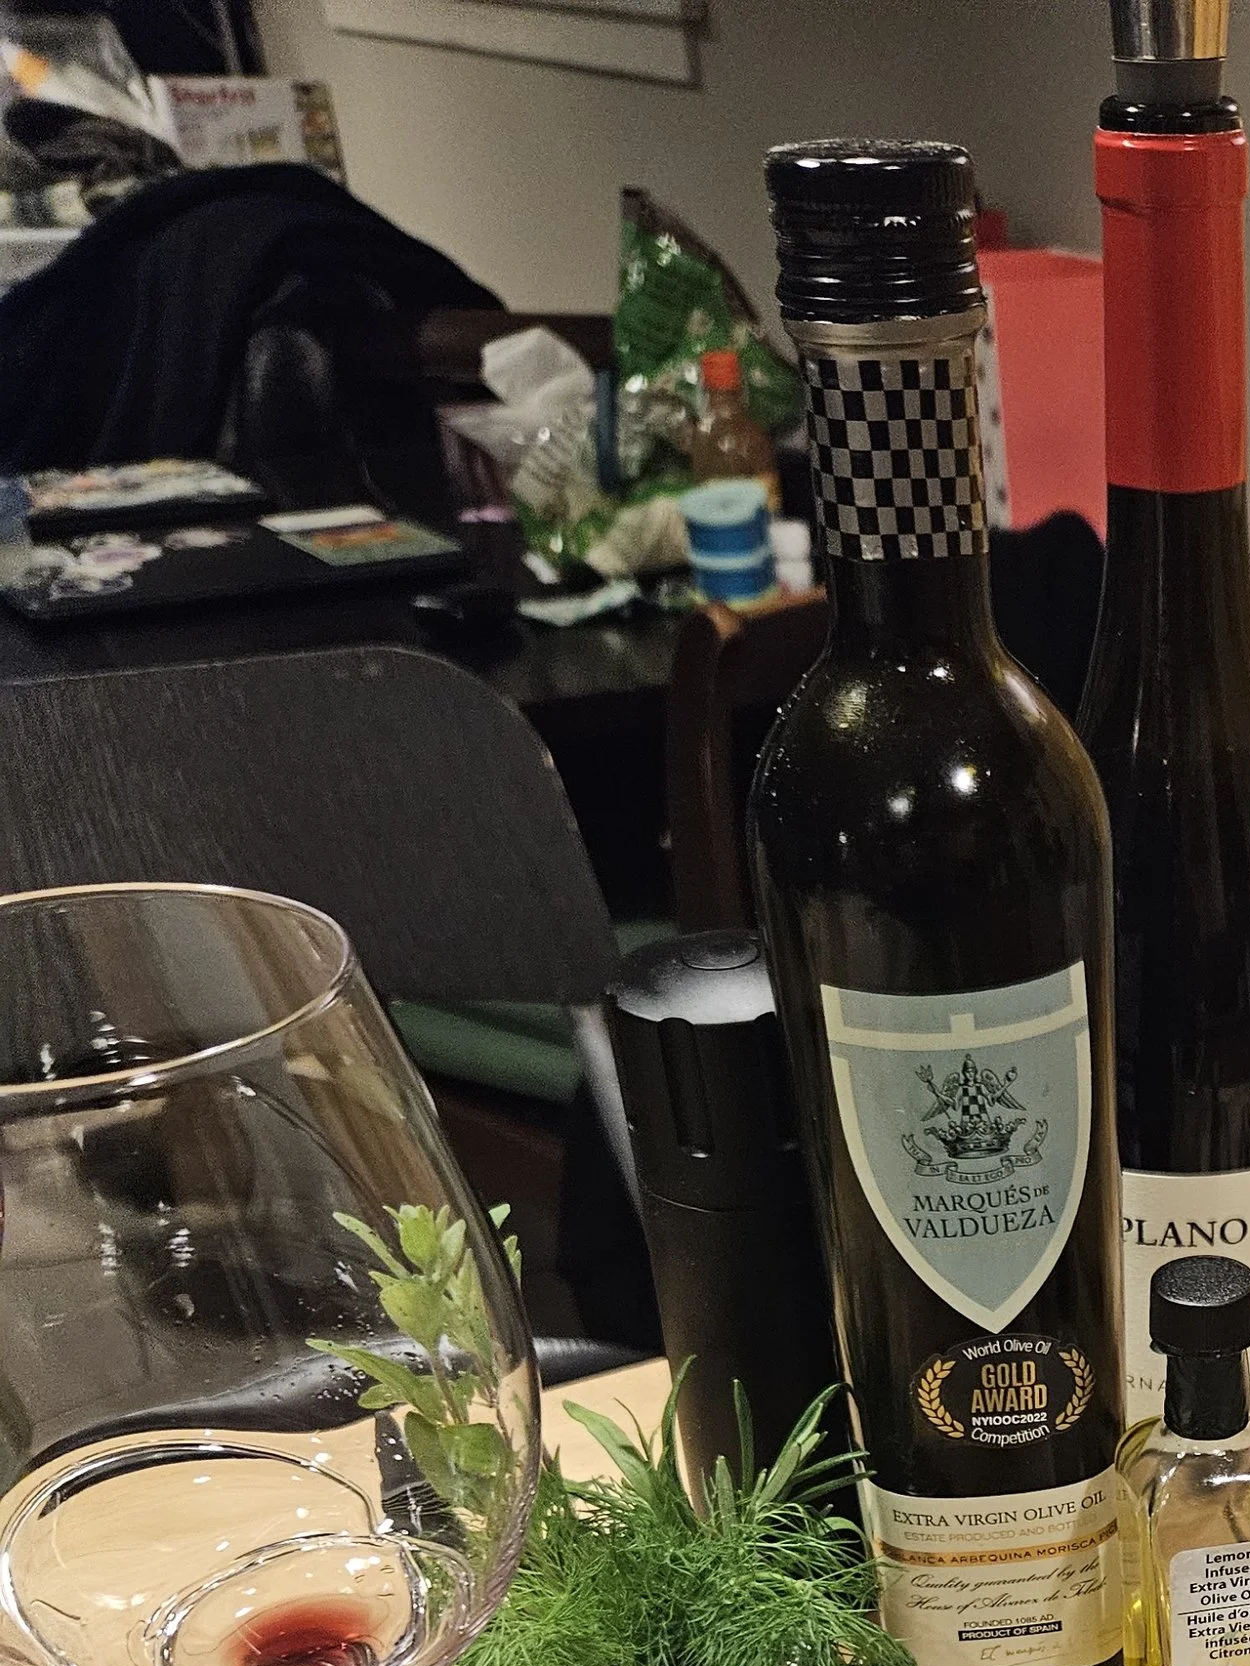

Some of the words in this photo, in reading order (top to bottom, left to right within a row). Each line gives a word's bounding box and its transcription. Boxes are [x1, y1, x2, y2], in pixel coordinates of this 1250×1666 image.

[912, 1184, 1031, 1214] MARQUÉS
[1033, 1185, 1050, 1198] DE
[903, 1204, 1056, 1239] VALDUEZA
[962, 1340, 1001, 1361] World
[1003, 1338, 1033, 1353] Olive
[1035, 1340, 1052, 1356] Oil
[981, 1360, 1037, 1389] GOLD
[971, 1384, 1049, 1414] AWARD
[971, 1424, 1051, 1448] Competition
[892, 1509, 950, 1527] EXTRA
[954, 1510, 1018, 1527] VIRGIN
[1023, 1501, 1077, 1521] OLIVE
[1081, 1490, 1107, 1510] OIL
[903, 1531, 946, 1543] ESTATE
[949, 1529, 1015, 1542] PRODUCED
[1019, 1526, 1044, 1537] AND
[951, 1551, 1032, 1564] ARBEQUINA
[1037, 1538, 1096, 1557] MORISCA
[910, 1573, 971, 1593] Quality
[970, 1567, 1060, 1592] guaranteed
[1056, 1564, 1076, 1581] by
[1080, 1555, 1100, 1575] the
[1189, 1581, 1227, 1594] Extra
[1201, 1593, 1238, 1606] Olive
[906, 1594, 953, 1611] House
[957, 1598, 979, 1615] of
[1043, 1589, 1062, 1603] de
[963, 1617, 1013, 1629] FOUNDED
[1015, 1615, 1037, 1625] 1085
[1187, 1612, 1225, 1626] Huile
[961, 1629, 1011, 1640] PRODUCT
[1013, 1626, 1027, 1636] OF
[1029, 1623, 1059, 1634] SPAIN
[1188, 1626, 1226, 1639] Extra
